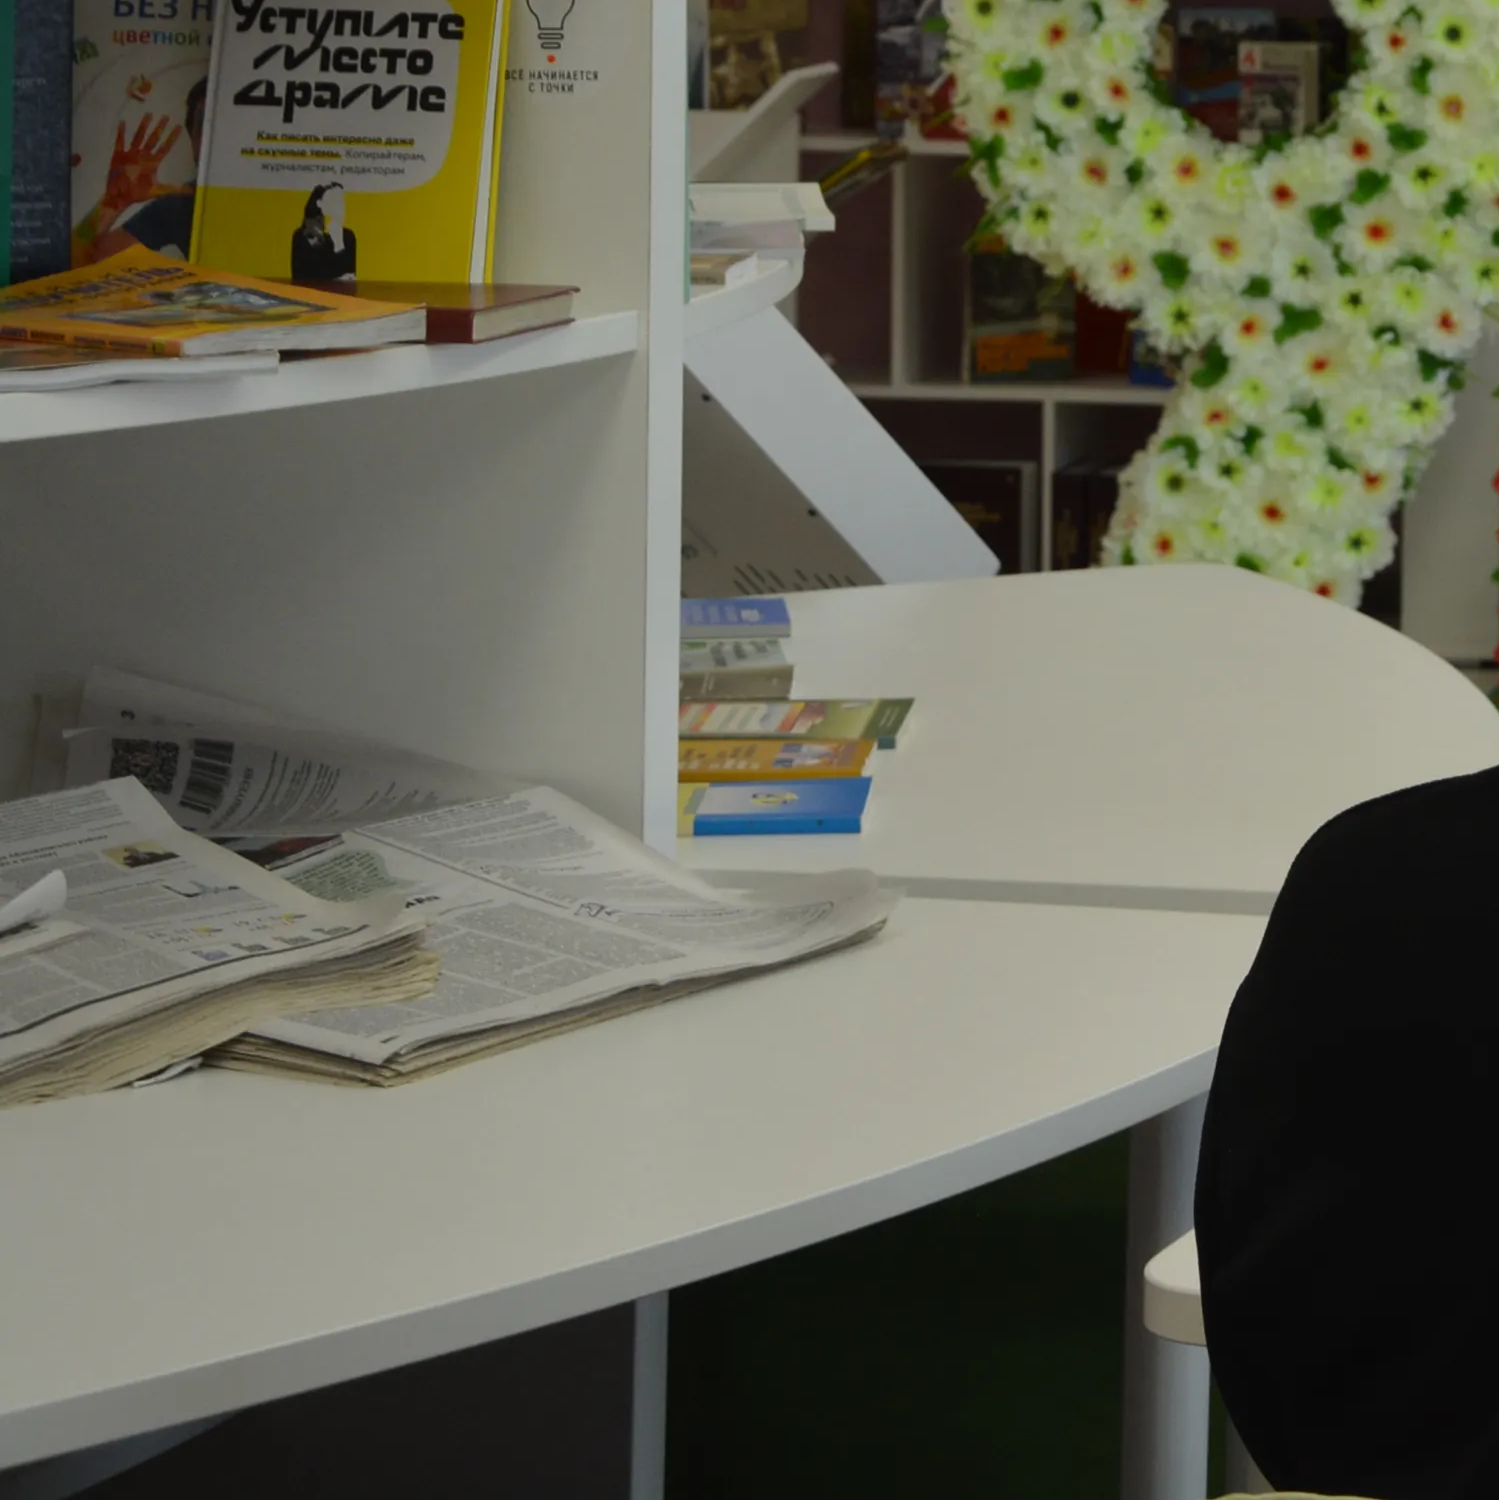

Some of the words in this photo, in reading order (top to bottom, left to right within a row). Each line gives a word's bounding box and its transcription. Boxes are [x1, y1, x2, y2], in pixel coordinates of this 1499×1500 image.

[112, 27, 200, 48] цветной
[529, 69, 600, 82] НАЧИНАЕТСЯ
[528, 81, 536, 94] С
[540, 82, 575, 95] ТОЧКИ
[233, 78, 447, 124] драме
[256, 130, 279, 143] Как
[281, 131, 321, 144] писать
[322, 133, 383, 146] интересно
[384, 135, 416, 147] даже
[241, 146, 255, 157] на
[257, 147, 309, 160] скучные
[340, 163, 406, 177] редакторам
